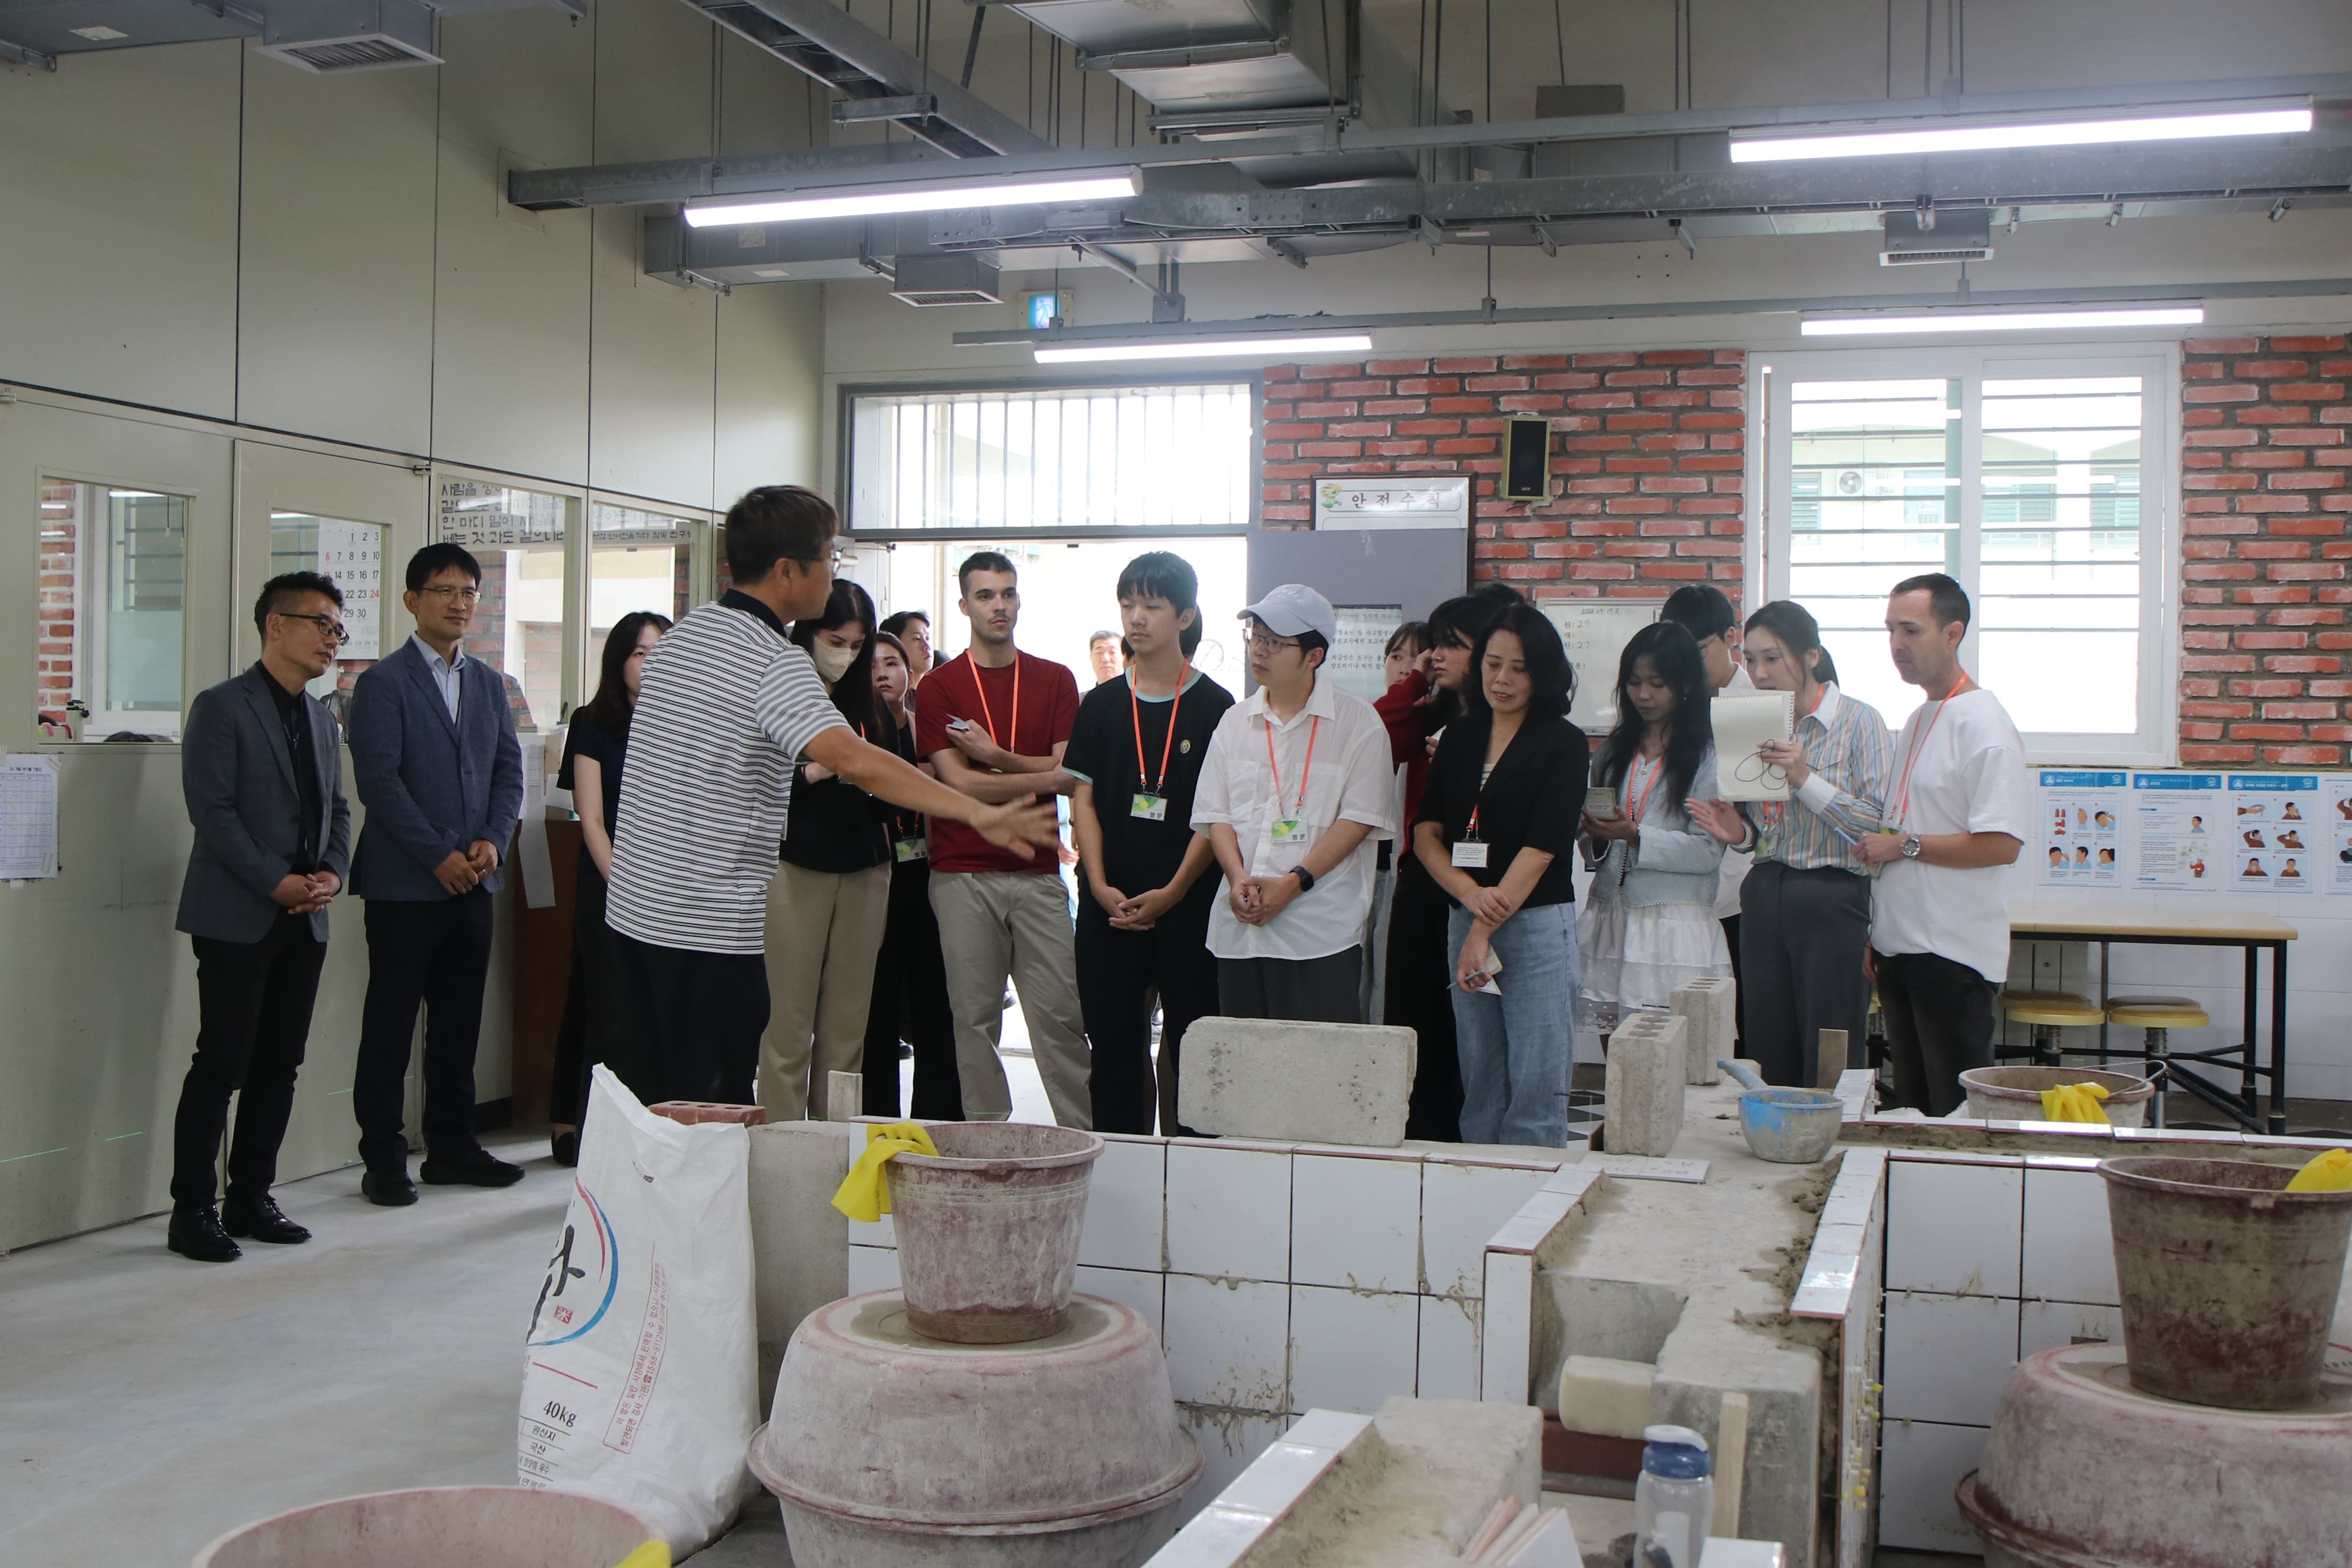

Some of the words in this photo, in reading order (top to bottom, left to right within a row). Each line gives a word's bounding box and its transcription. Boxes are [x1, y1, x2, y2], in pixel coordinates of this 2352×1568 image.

[441, 482, 476, 497] 사람을
[443, 516, 455, 530] 한
[459, 515, 484, 528] 마디
[489, 515, 514, 528] 말이
[362, 532, 368, 541] 2
[374, 531, 379, 541] 3
[472, 531, 485, 544] 것
[489, 530, 515, 544] 과도
[325, 552, 330, 561] 6
[337, 552, 342, 561] 7
[349, 552, 354, 560] 8
[362, 551, 367, 560] 9
[373, 551, 380, 560] 10
[335, 571, 342, 580] 14
[347, 571, 355, 579] 15
[360, 571, 367, 579] 16
[373, 570, 379, 579] 17
[345, 590, 355, 599] 22
[358, 590, 367, 598] 23
[370, 590, 379, 598] 24
[343, 609, 353, 618] 29
[357, 609, 366, 618] 30
[626, 1385, 638, 1399] 일반
[632, 1354, 647, 1383] 시장에서
[650, 1297, 659, 1319] 없으니
[543, 1400, 577, 1428] 40kg
[620, 1418, 636, 1447] 발견되면
[631, 1402, 643, 1416] 검사
[532, 1424, 556, 1442] 원산지
[530, 1441, 546, 1456] 국산
[539, 1463, 551, 1475] 우수
